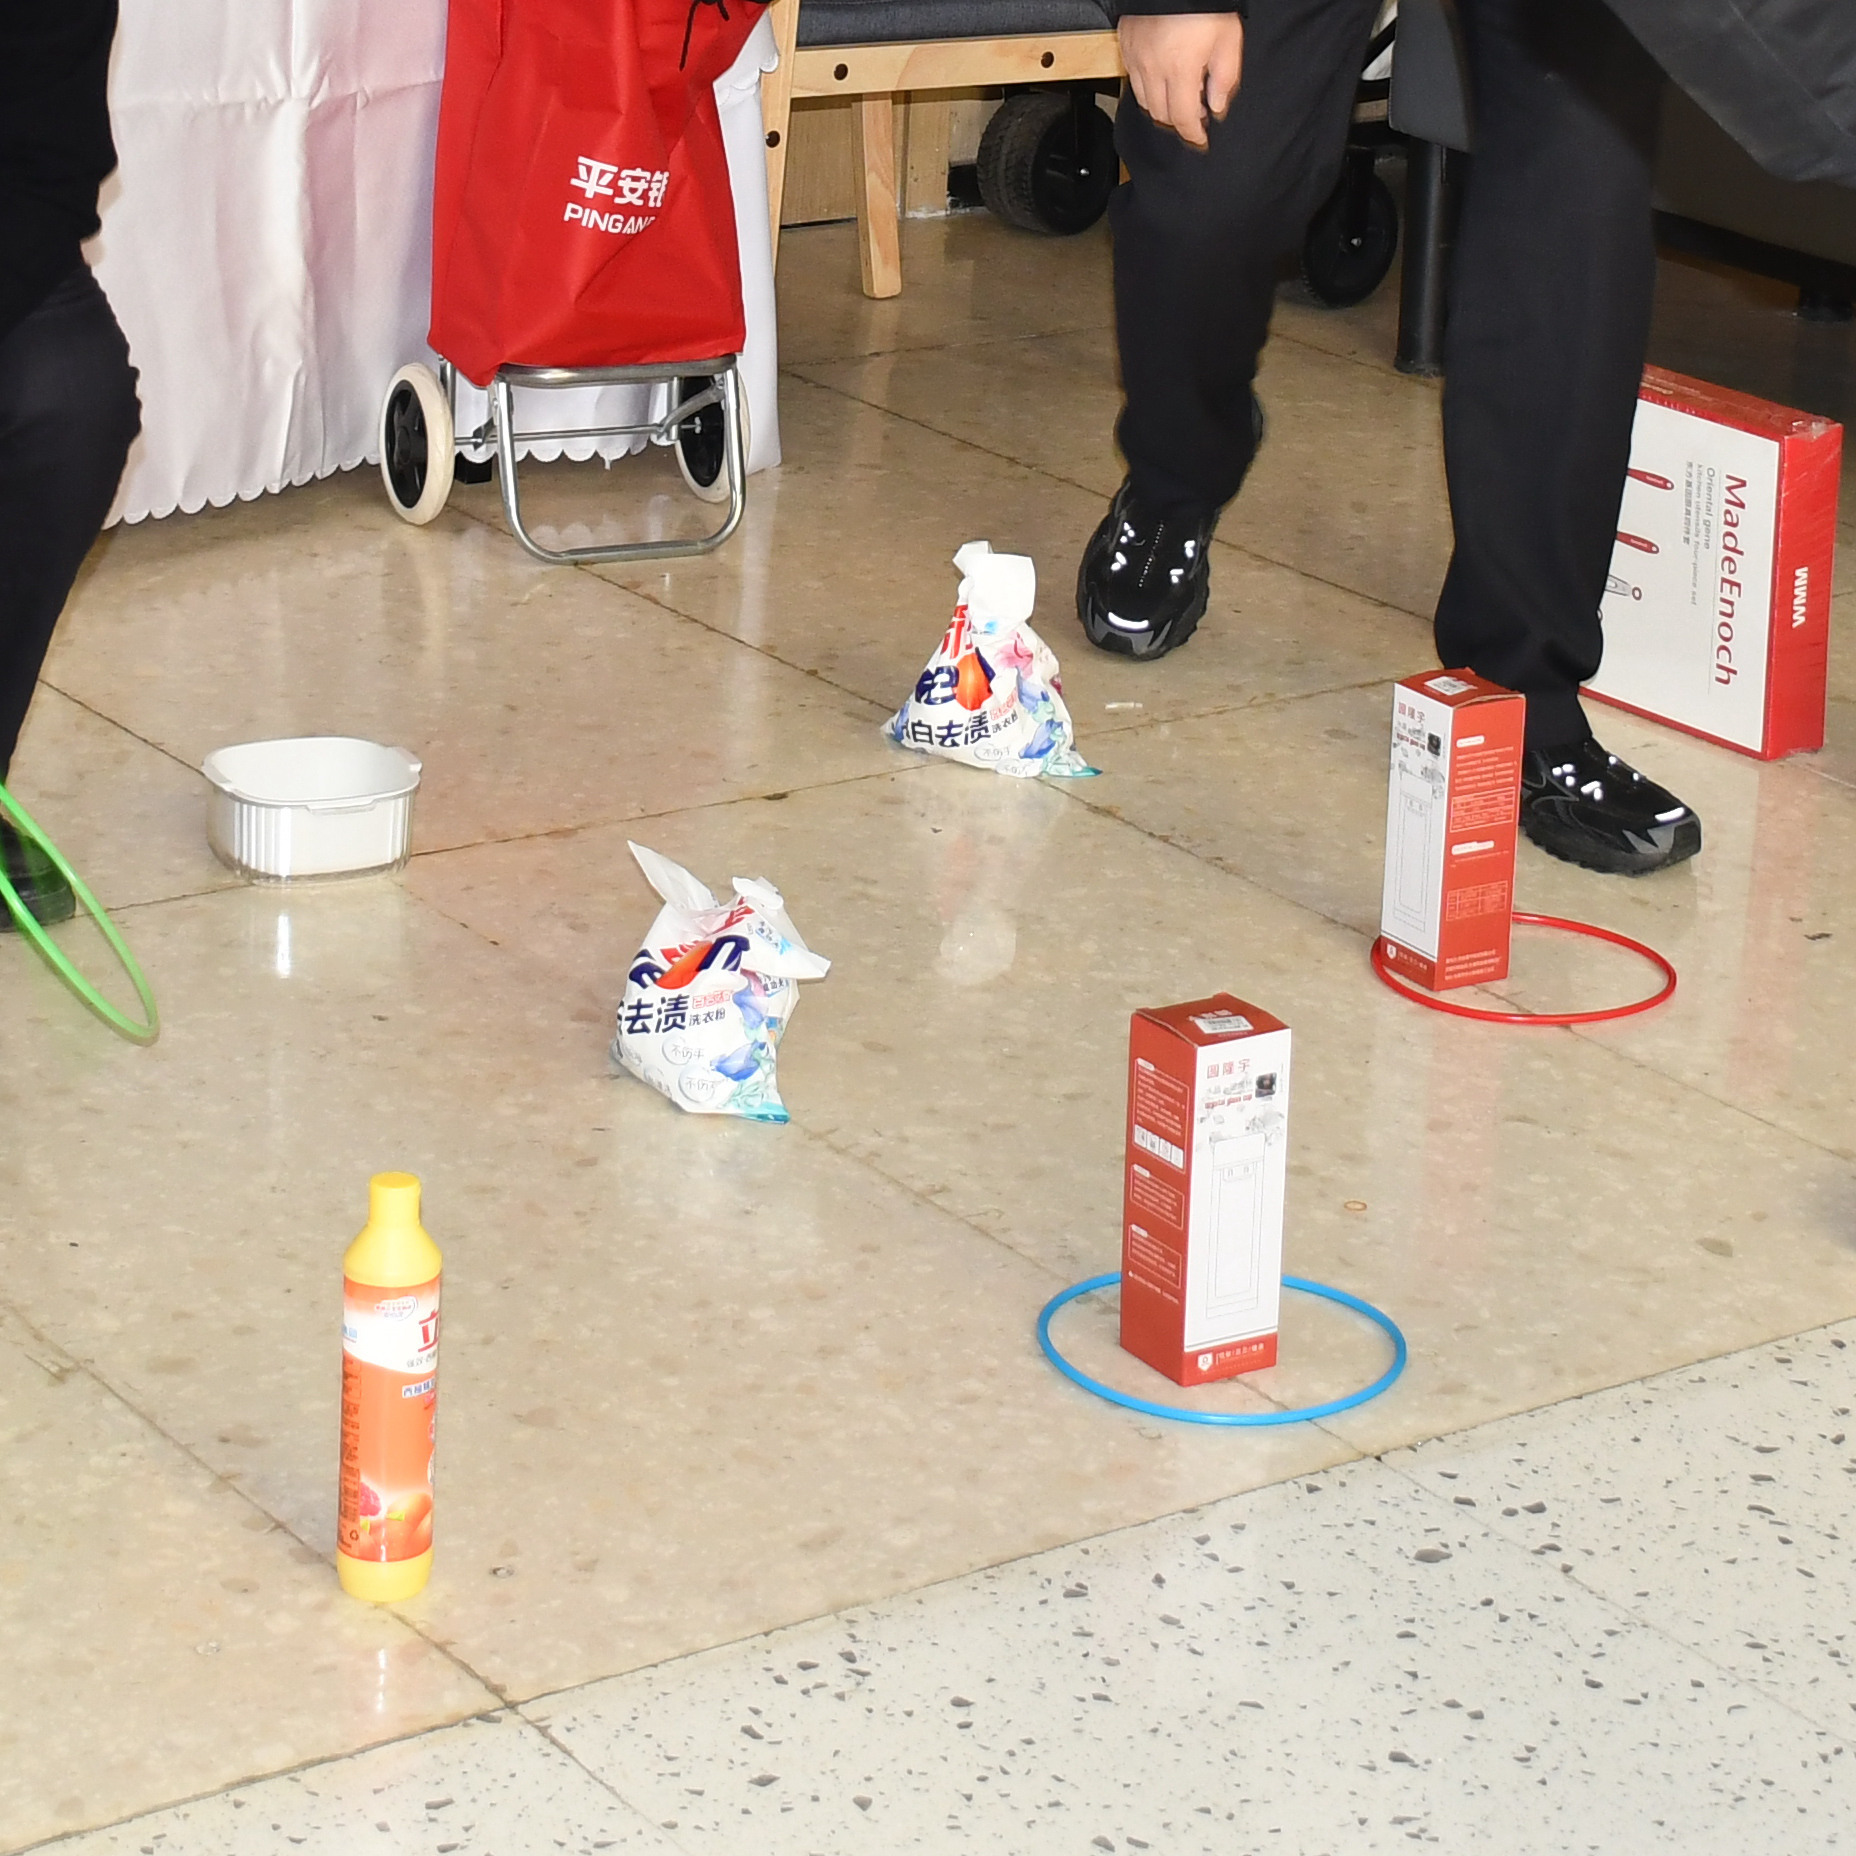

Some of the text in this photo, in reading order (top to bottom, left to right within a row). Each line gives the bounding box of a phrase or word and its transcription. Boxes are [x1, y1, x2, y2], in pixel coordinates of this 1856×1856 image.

[1714, 473, 1748, 686] MadeEnoch
[903, 710, 991, 748] 白去渍
